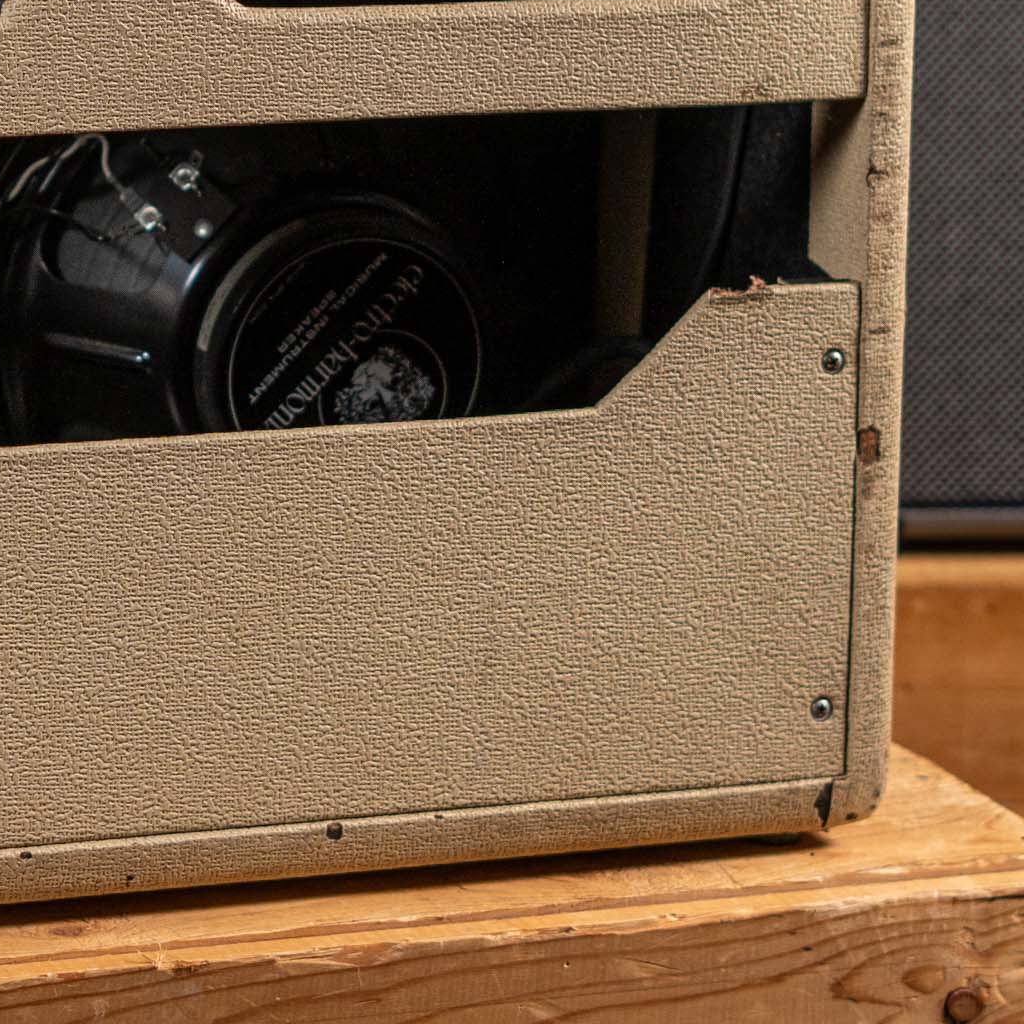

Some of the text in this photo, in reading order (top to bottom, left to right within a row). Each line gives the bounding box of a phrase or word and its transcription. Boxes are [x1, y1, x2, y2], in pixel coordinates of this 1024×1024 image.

[248, 317, 330, 405] INSTRUMENT
[264, 264, 424, 429] electro-harmoni
[277, 289, 337, 354] SPEAKER
